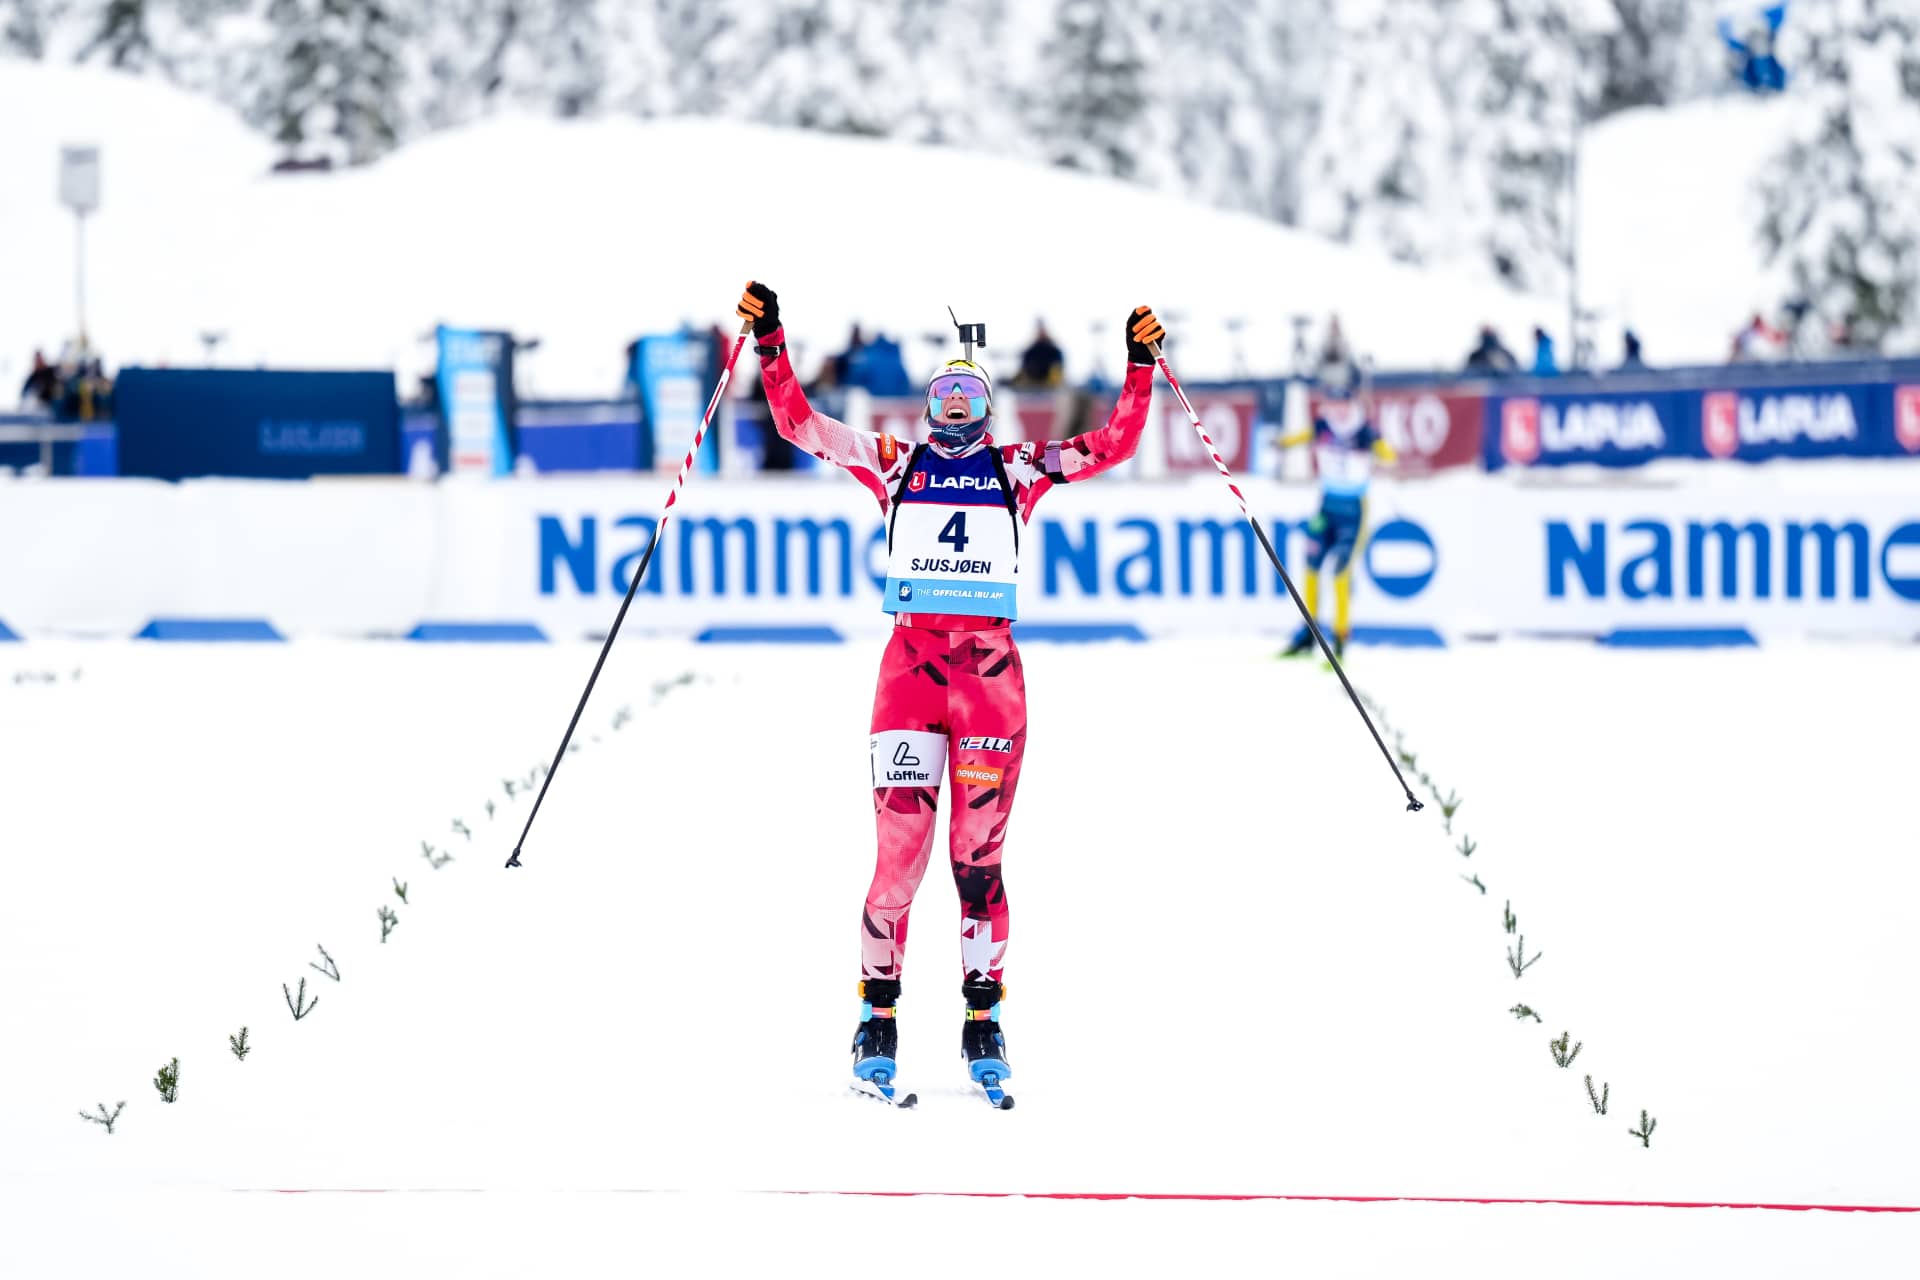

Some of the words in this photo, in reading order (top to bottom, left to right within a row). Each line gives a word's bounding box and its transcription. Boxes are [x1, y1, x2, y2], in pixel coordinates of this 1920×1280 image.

[1739, 392, 1858, 445] LAPUA
[1541, 402, 1666, 452] LAPUA
[929, 474, 1003, 491] LAPUA
[938, 511, 969, 552] 4
[538, 515, 886, 595] Namm
[911, 558, 991, 574] SJUSJØEN
[916, 588, 932, 597] THE
[933, 589, 973, 598] OFFICIAL
[974, 590, 990, 599] IBU
[960, 737, 1010, 752] HELLA
[886, 770, 930, 781] Löffler
[957, 769, 999, 782] newkee
